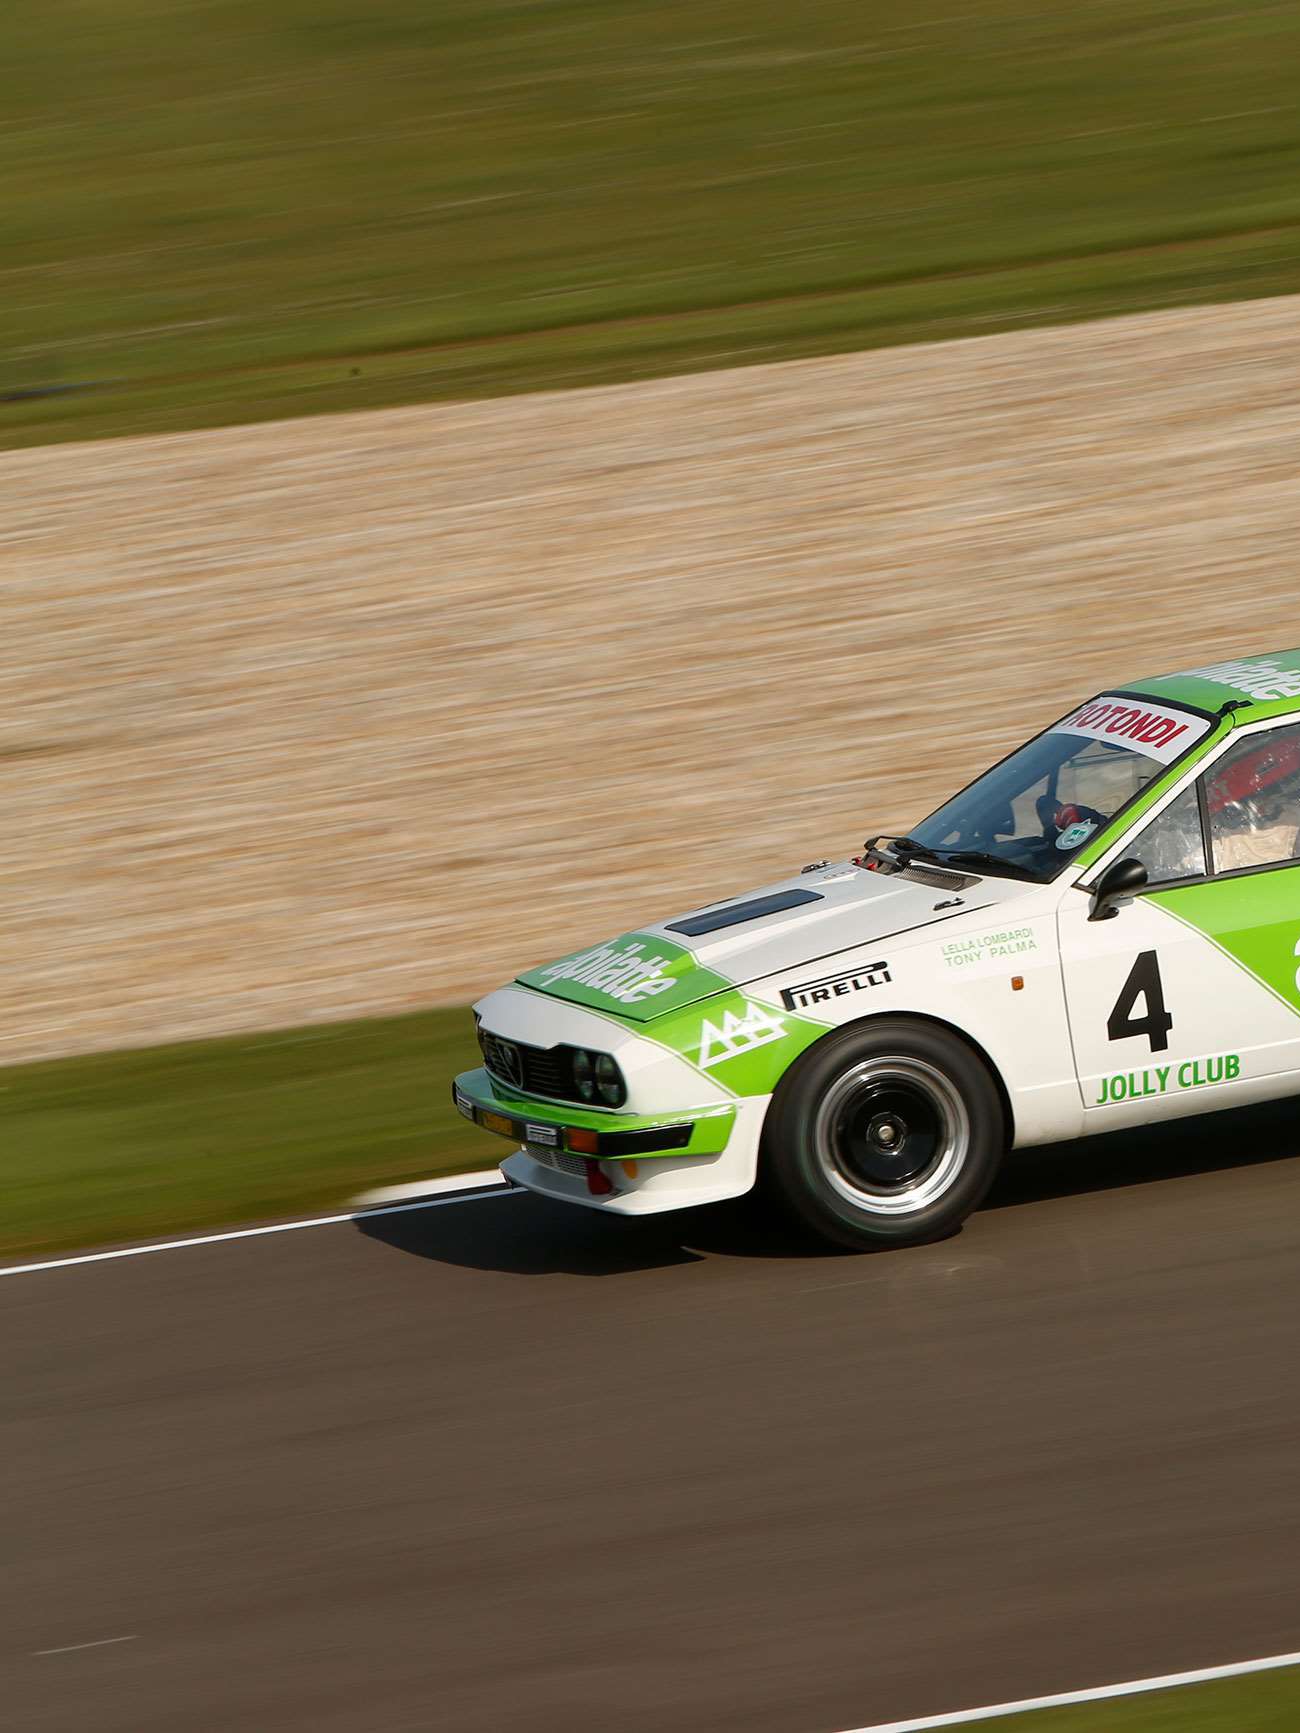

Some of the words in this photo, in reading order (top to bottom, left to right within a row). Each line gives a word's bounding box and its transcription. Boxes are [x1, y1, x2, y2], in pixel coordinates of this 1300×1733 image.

[1061, 704, 1189, 749] ROTONDI
[941, 941, 976, 955] LELLA
[976, 927, 1034, 948] LOMBARDI
[944, 951, 982, 967] TONY
[990, 940, 1038, 957] PALMA
[779, 960, 891, 1011] PIRELLI
[1107, 950, 1172, 1053] 4
[1097, 1061, 1170, 1104] JOLLY
[1178, 1054, 1240, 1089] CLUB
